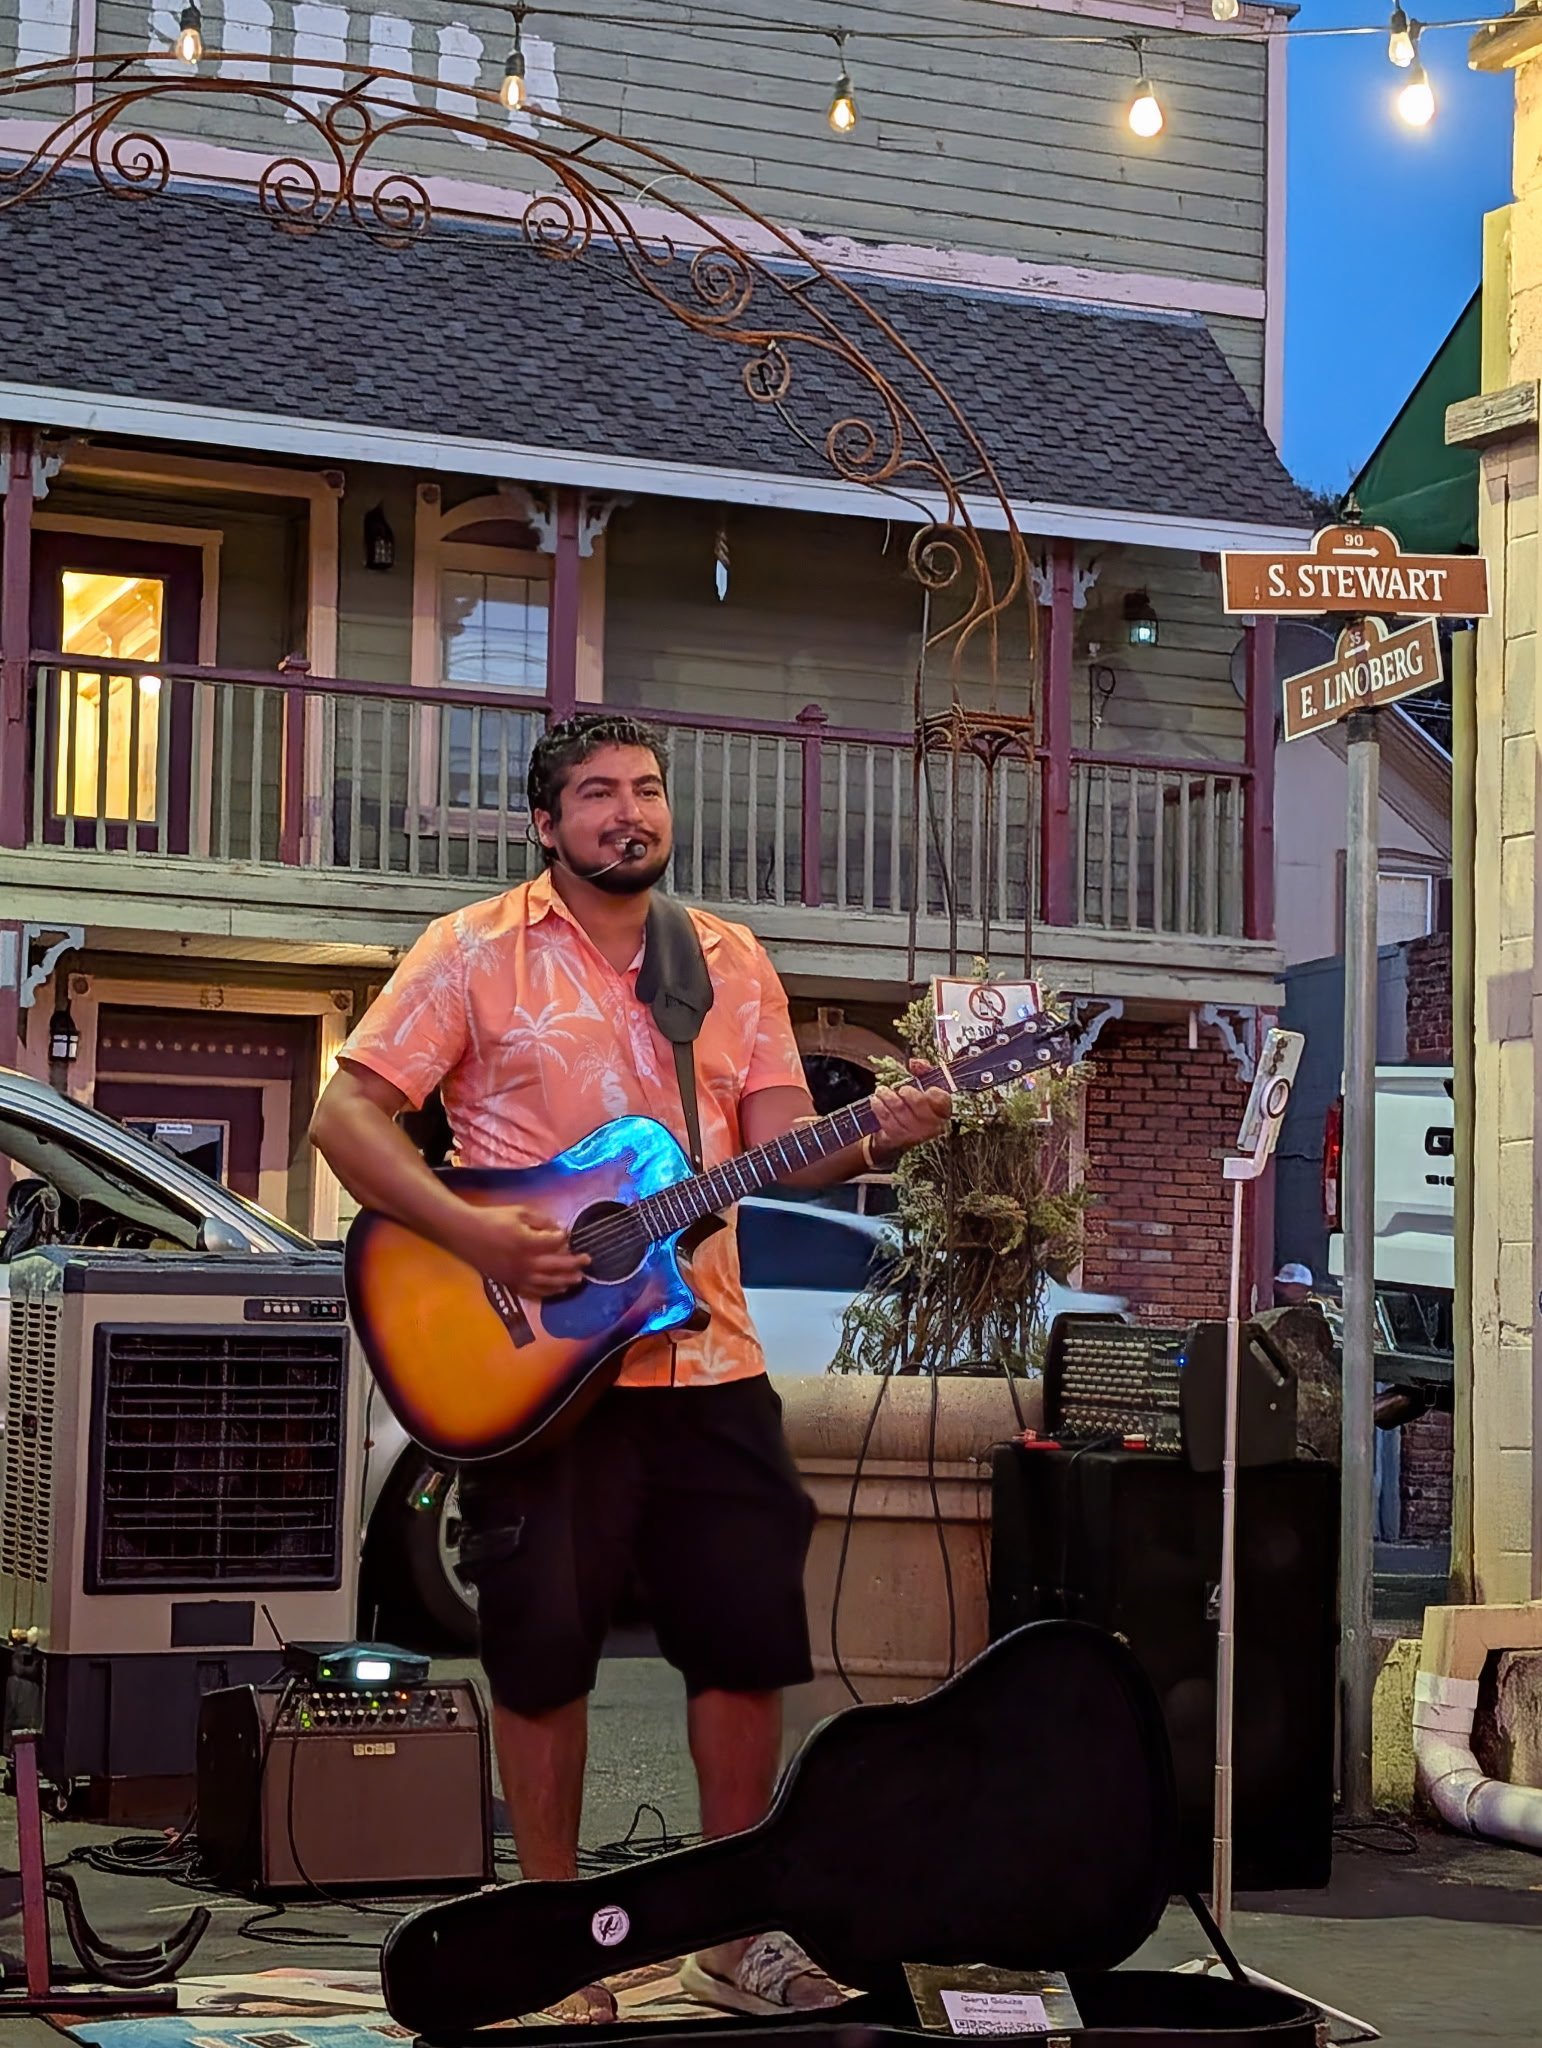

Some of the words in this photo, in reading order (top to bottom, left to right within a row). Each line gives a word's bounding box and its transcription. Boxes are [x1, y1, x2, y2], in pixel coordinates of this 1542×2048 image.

[1344, 534, 1364, 547] 90
[1268, 564, 1292, 597] S.
[1298, 564, 1448, 601] STEWART
[1301, 685, 1318, 719] E.
[1324, 640, 1424, 710] LINOBERG
